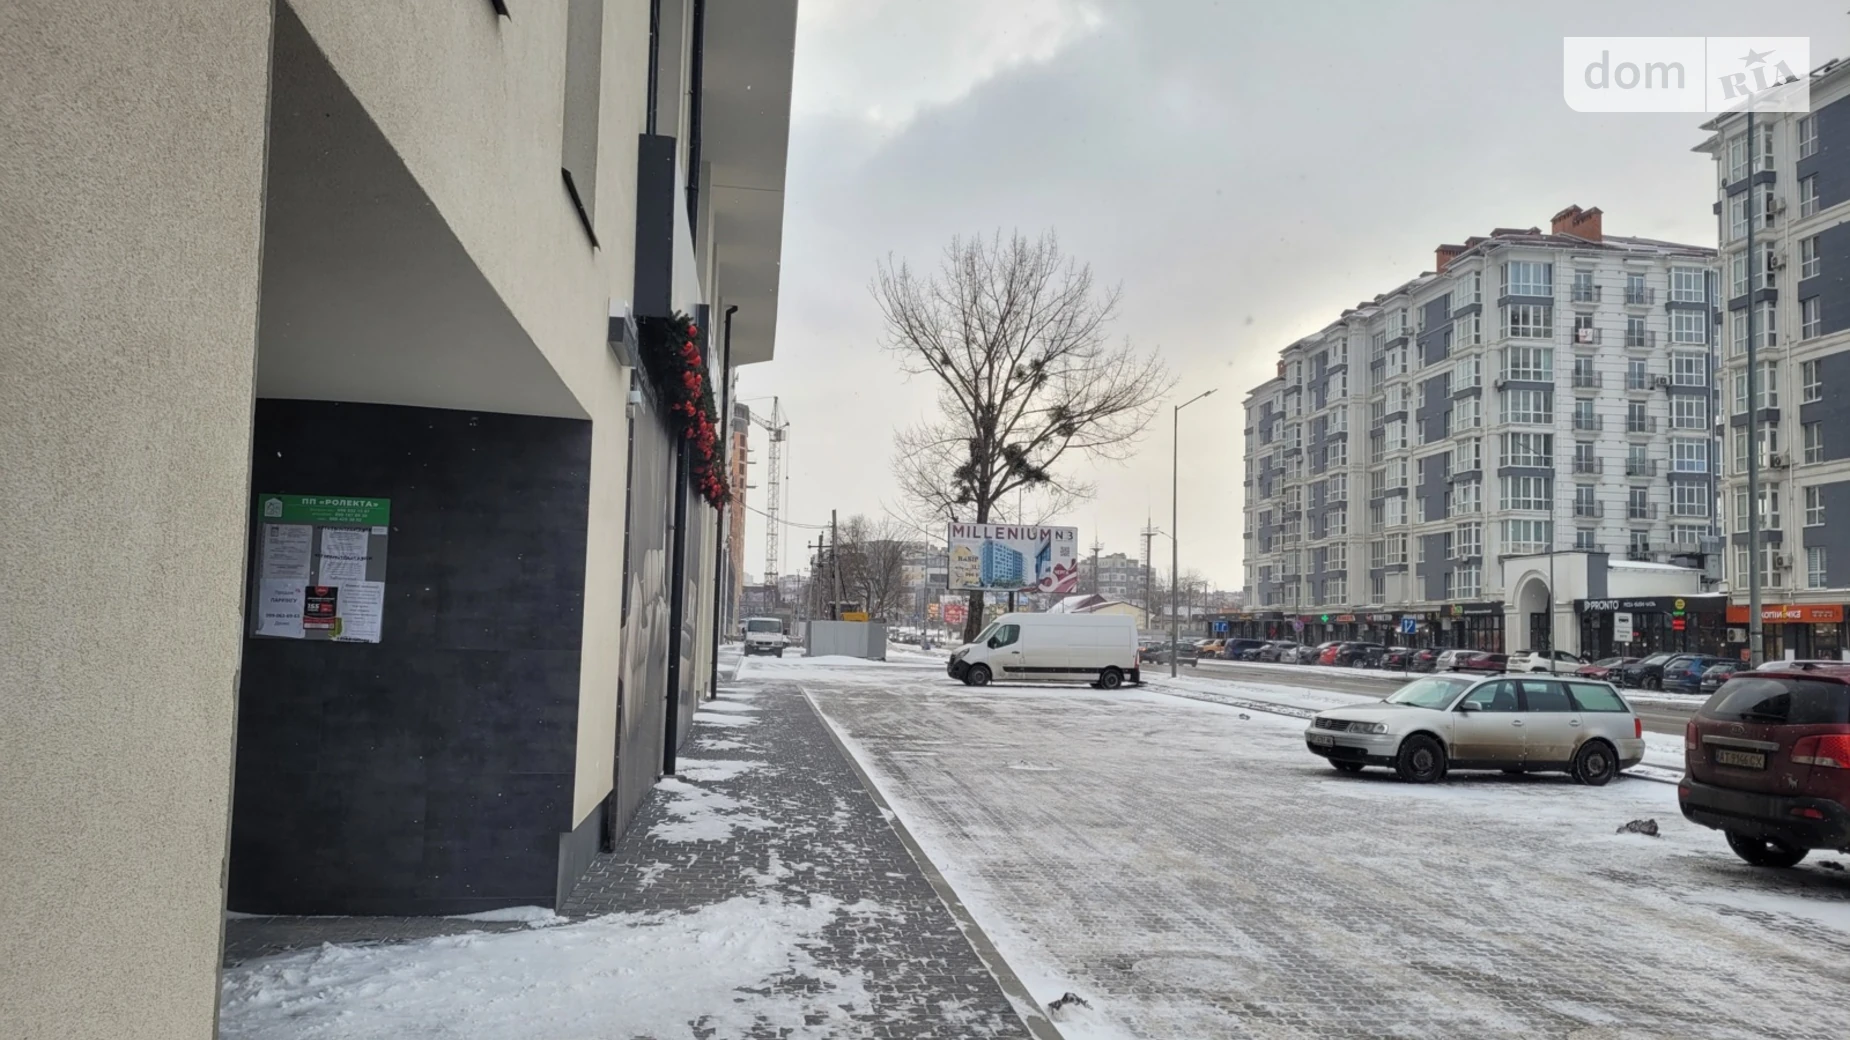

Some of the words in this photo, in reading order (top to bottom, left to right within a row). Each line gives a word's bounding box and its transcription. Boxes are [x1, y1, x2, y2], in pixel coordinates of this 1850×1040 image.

[319, 499, 379, 507] «РОЛЕКТА»
[952, 525, 1051, 540] MILLENIUM
[1067, 531, 1074, 540] 3
[1590, 600, 1620, 611] PRONTO
